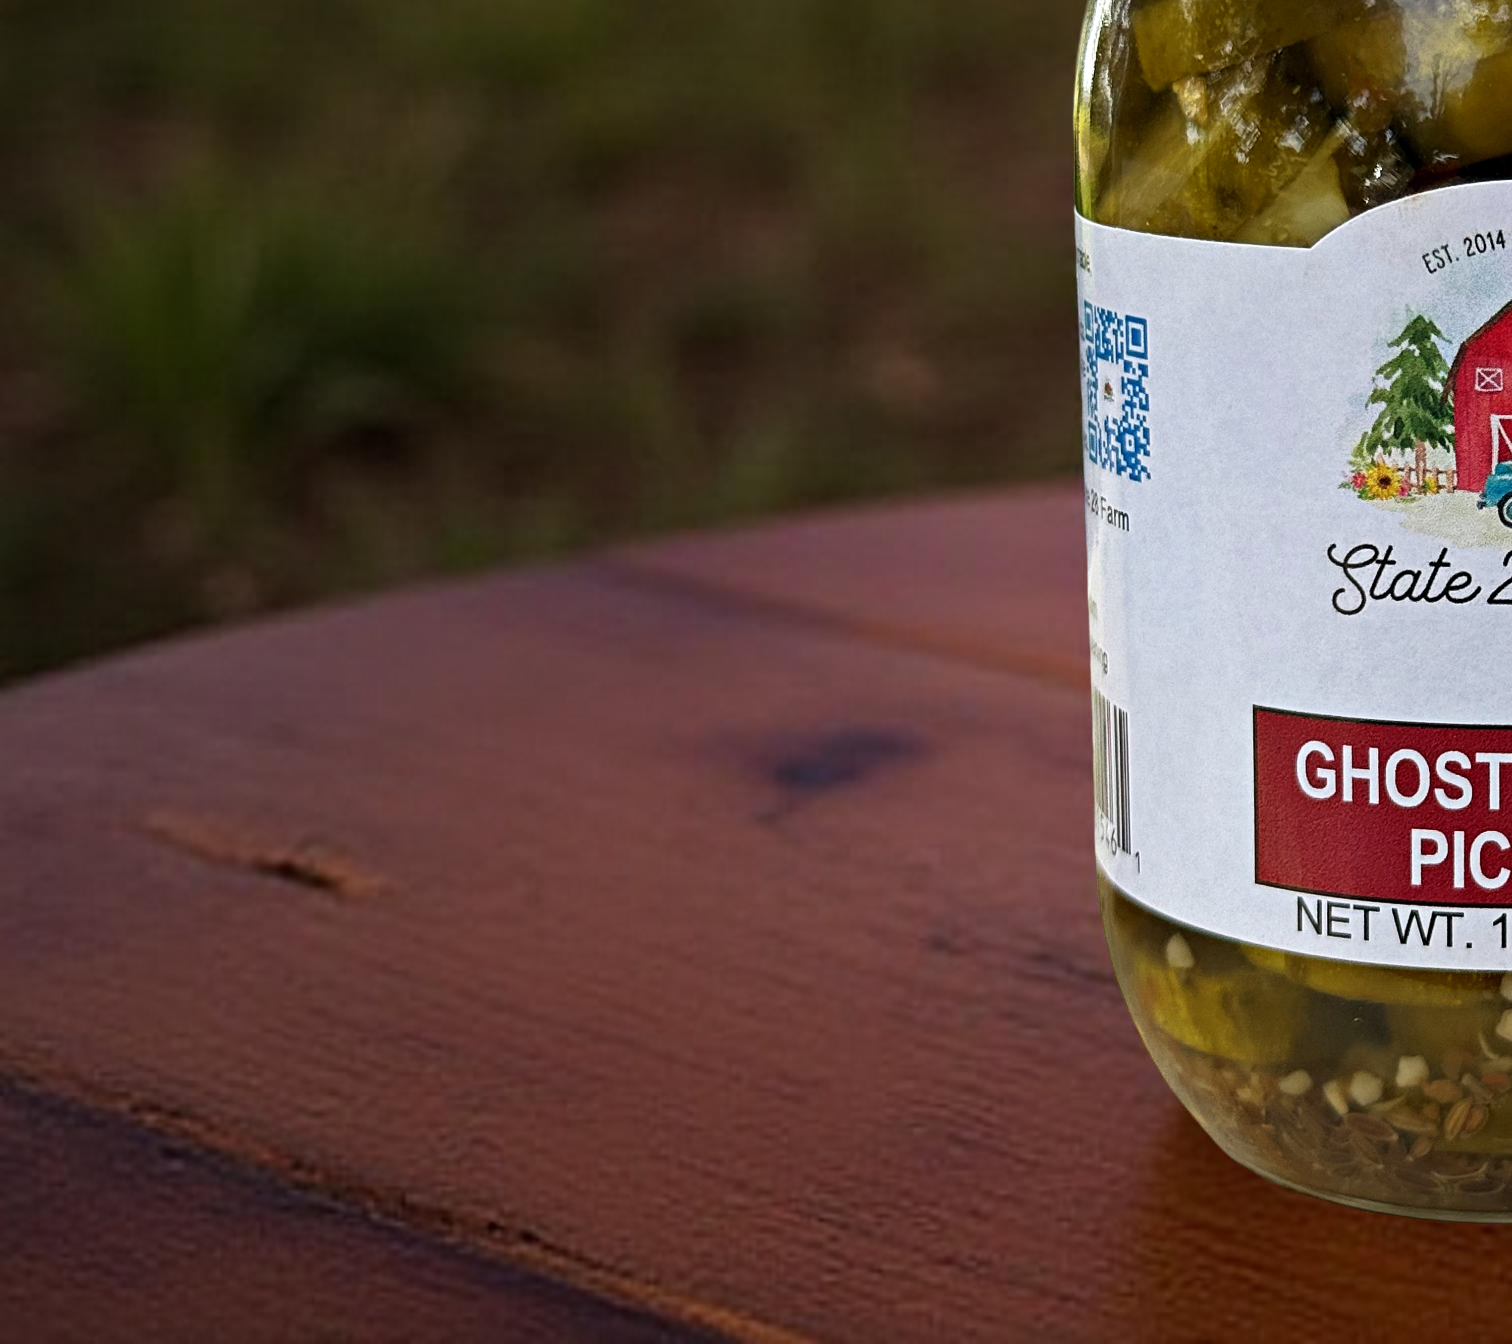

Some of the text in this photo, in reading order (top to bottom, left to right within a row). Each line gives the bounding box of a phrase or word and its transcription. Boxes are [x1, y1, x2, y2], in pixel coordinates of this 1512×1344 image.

[1422, 244, 1460, 274] EST.
[1463, 230, 1506, 257] 2014
[1100, 495, 1130, 532] Farm
[1327, 543, 1482, 616] State
[1296, 896, 1380, 941] NET
[1391, 907, 1473, 949] WT.
